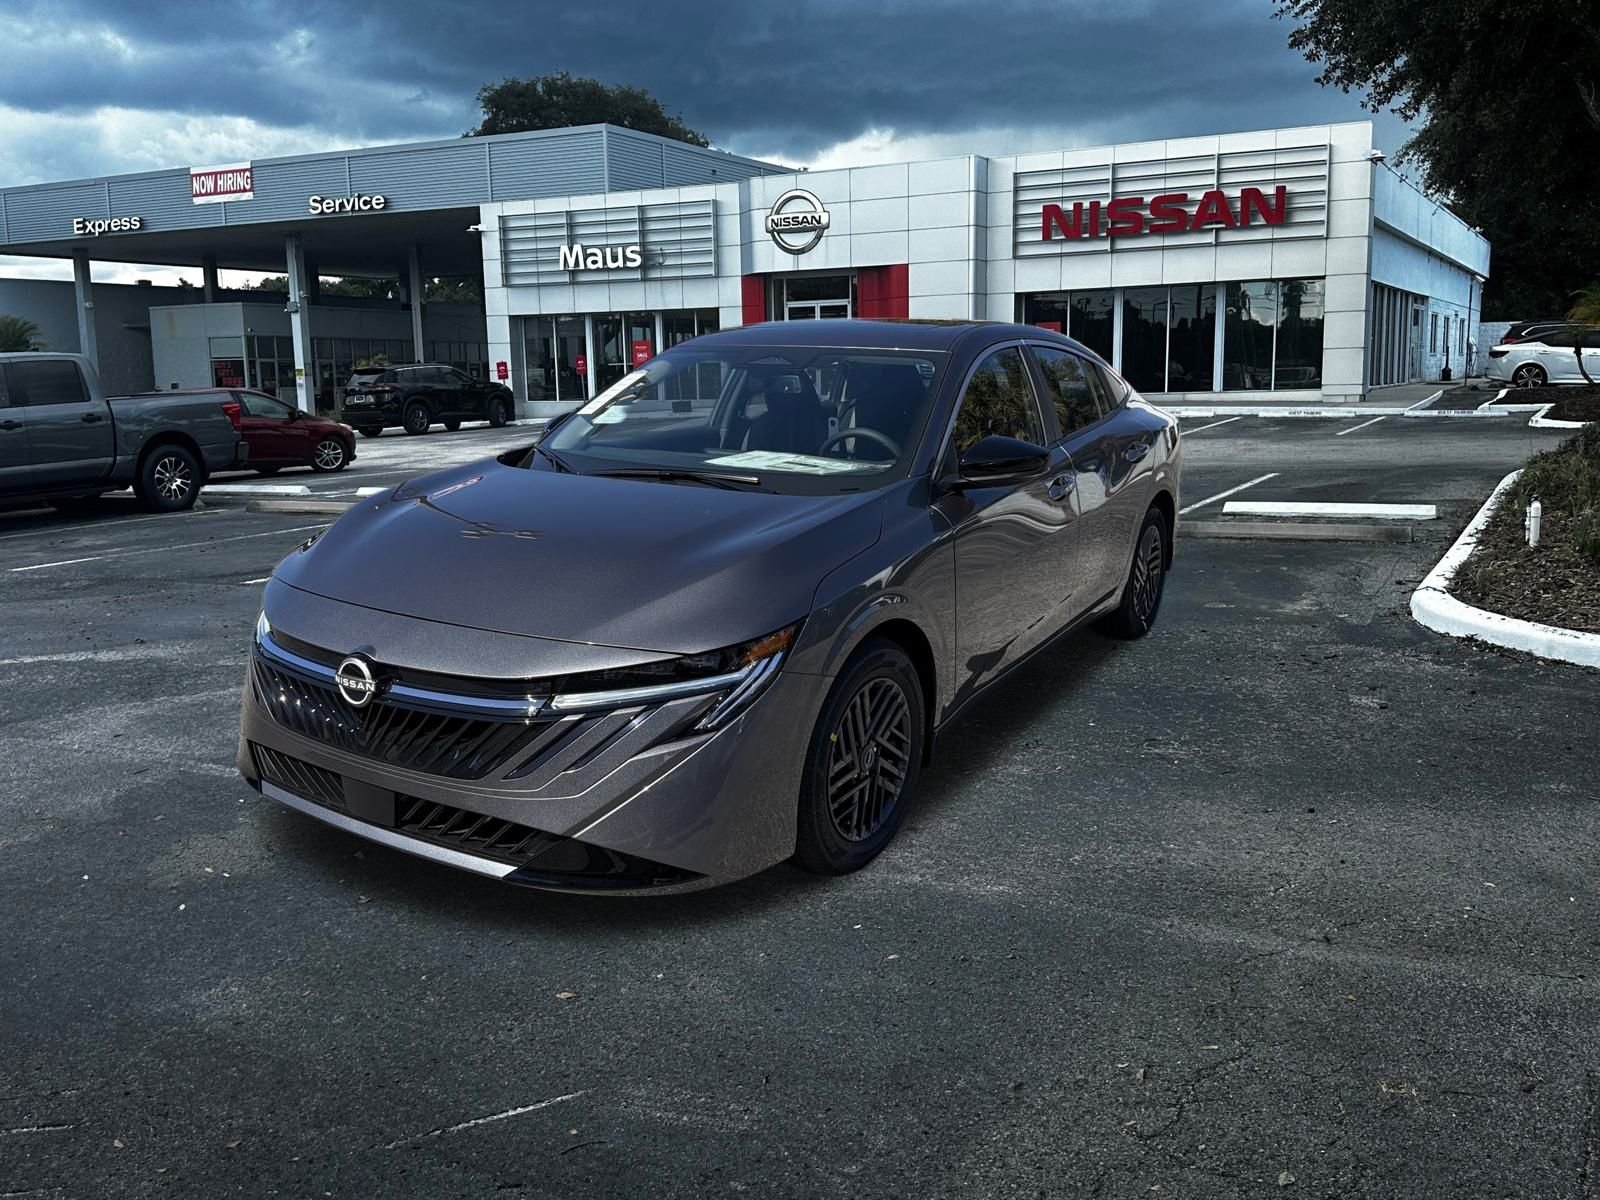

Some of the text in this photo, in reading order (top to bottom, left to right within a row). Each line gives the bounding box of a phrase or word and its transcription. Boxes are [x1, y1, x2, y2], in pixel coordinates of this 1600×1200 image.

[192, 170, 251, 195] NOW HIRING
[308, 193, 385, 214] Service
[1041, 185, 1287, 241] NISSAN
[73, 216, 141, 236] Express
[770, 215, 822, 228] NISSAN
[559, 244, 642, 270] Maus
[335, 675, 375, 691] NISSAN
